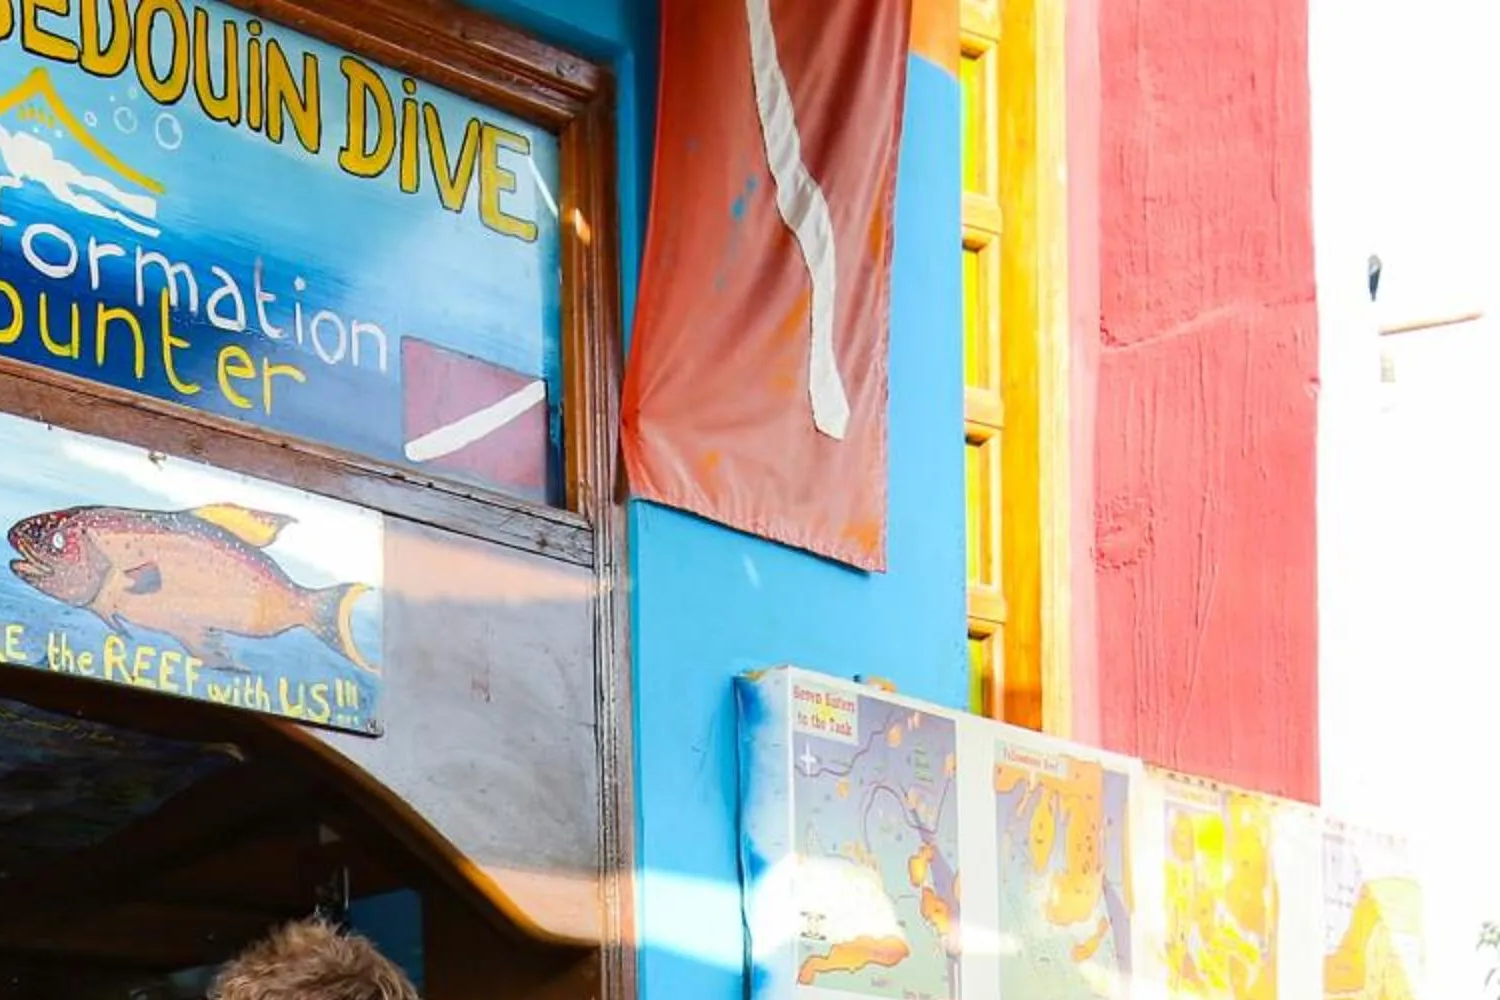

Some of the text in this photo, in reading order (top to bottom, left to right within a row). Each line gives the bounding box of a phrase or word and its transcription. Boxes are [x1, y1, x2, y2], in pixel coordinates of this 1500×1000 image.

[47, 632, 95, 677] the
[102, 634, 203, 696] REEF
[206, 674, 272, 713] with
